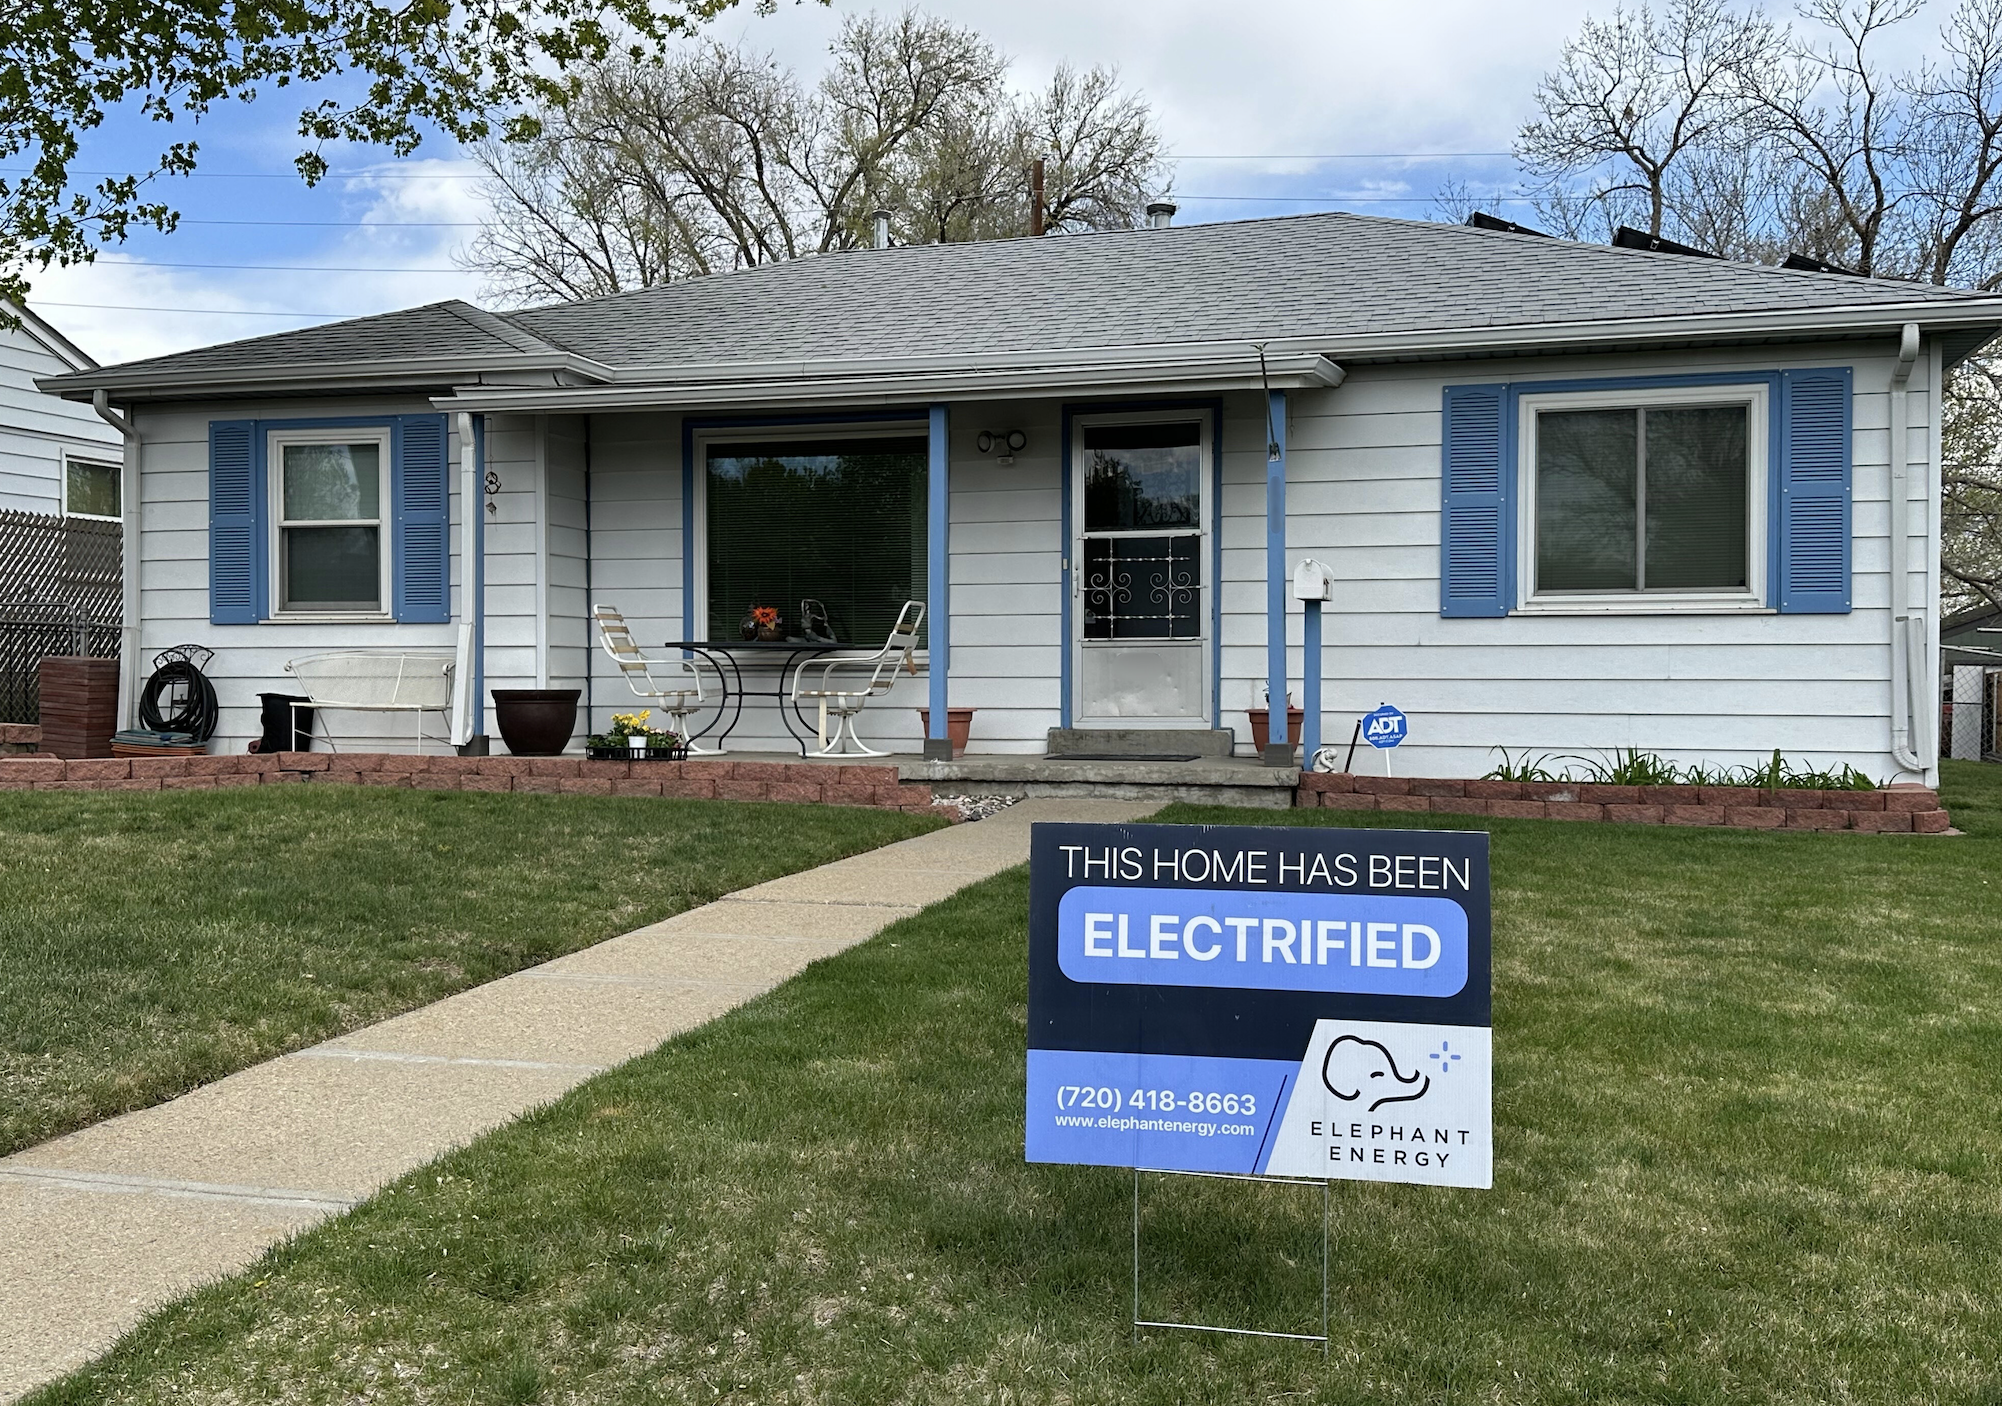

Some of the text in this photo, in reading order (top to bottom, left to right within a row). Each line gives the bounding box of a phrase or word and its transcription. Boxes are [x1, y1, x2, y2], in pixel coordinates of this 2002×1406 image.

[1367, 716, 1403, 735] ADT
[1059, 845, 1470, 891] THIS HOME HAS BEEN
[1084, 912, 1442, 970] ELECTRIFIED
[1057, 1086, 1256, 1115] (720) 418-8663
[1055, 1113, 1255, 1136] www.elephantenergy.com
[1311, 1121, 1470, 1145] ELEPHANT
[1329, 1145, 1450, 1168] ENERGY
